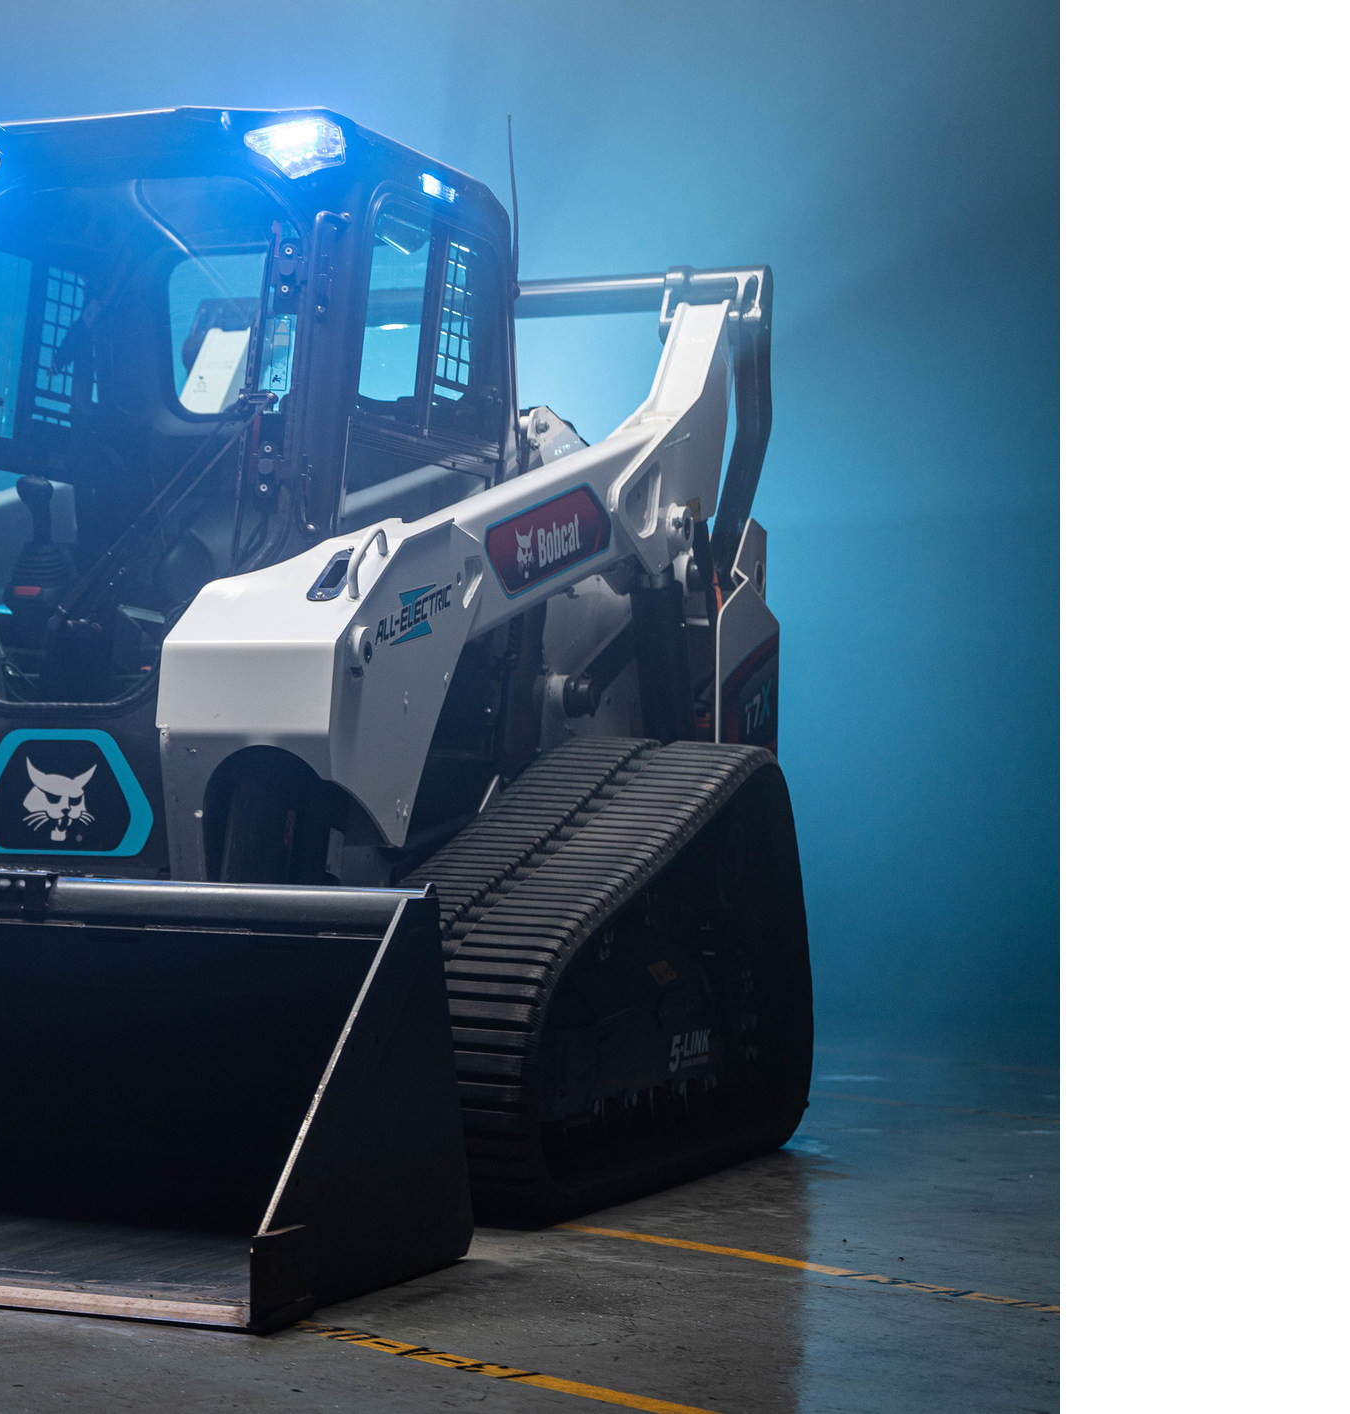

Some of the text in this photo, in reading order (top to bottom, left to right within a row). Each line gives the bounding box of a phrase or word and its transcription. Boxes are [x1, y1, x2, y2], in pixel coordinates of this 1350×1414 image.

[537, 513, 581, 568] Bobcat
[374, 583, 453, 646] ALL-ELECTRIC
[745, 678, 773, 735] T7X
[669, 1028, 711, 1072] 5-LINK
